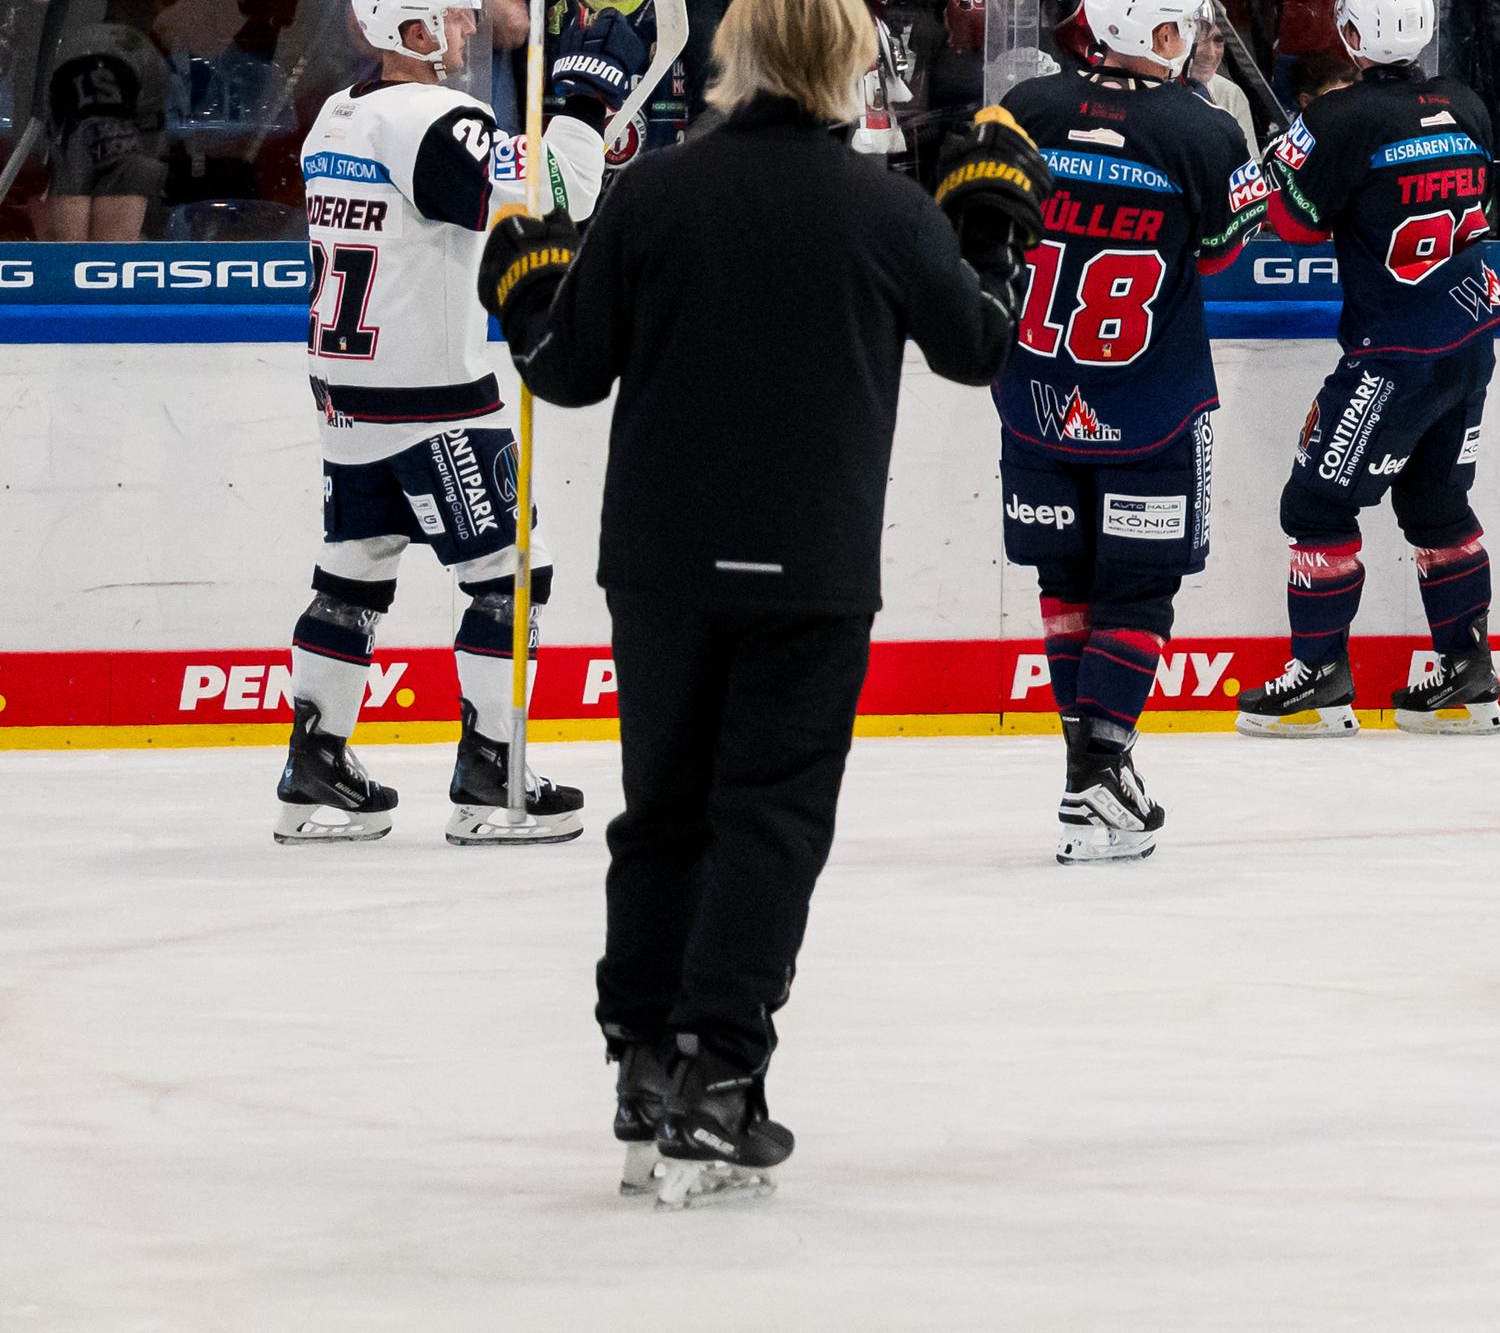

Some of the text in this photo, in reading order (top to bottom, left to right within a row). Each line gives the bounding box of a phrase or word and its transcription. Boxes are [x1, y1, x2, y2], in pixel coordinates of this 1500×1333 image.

[1040, 150, 1096, 178] BÄREN
[1384, 136, 1451, 164] EISBÄREN
[335, 156, 378, 180] STROM
[1396, 167, 1487, 205] TIFFELS
[308, 195, 389, 232] DERER
[75, 260, 308, 289] GASAG
[1018, 238, 1168, 368] 18
[1317, 370, 1381, 480] CONTIPARK
[1368, 454, 1410, 476] Jee
[1006, 493, 1076, 531] Jeep
[1108, 514, 1181, 529] KÖNIG
